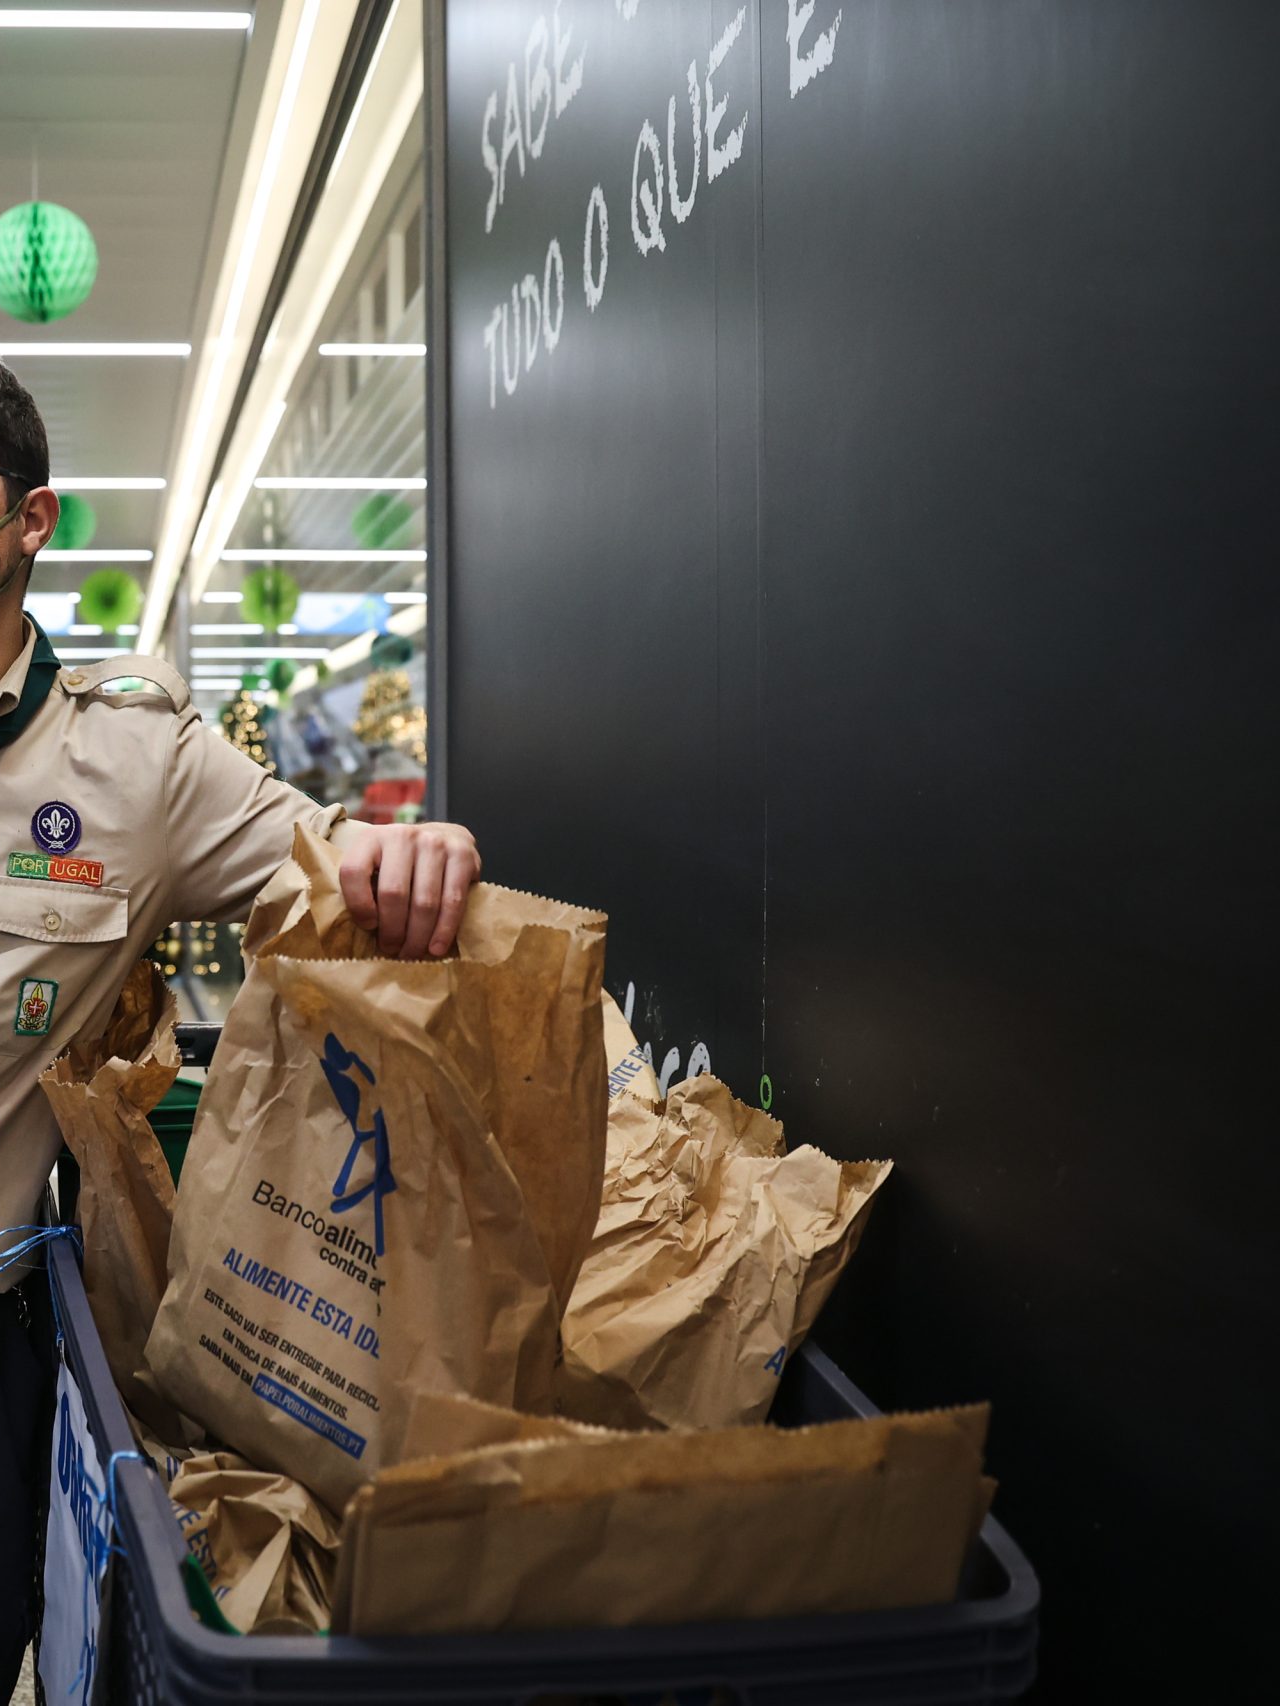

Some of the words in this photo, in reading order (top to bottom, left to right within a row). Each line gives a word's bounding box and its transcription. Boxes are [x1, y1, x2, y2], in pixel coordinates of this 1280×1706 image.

[484, 238, 564, 409] TUDO
[583, 183, 608, 313] O
[631, 5, 748, 257] QUE
[12, 857, 99, 881] PORTUGAL
[222, 1248, 313, 1312] ALIMENTE
[310, 1297, 354, 1340] ESTA
[319, 1246, 368, 1285] contra
[199, 1334, 222, 1361] SAIBA
[222, 1352, 242, 1376] MAIS
[240, 1368, 254, 1387] EM
[204, 1287, 224, 1311] ESTE
[223, 1302, 244, 1327] SACO
[243, 1318, 260, 1338] VAI
[258, 1328, 280, 1348] SER
[278, 1338, 324, 1376] ENTREGUE
[321, 1366, 347, 1391] PARA
[222, 1327, 235, 1344] EM
[235, 1338, 261, 1365] TROCA
[260, 1356, 277, 1373] DE
[275, 1365, 300, 1388] MAIS
[298, 1380, 348, 1421] ALIMENTOS.
